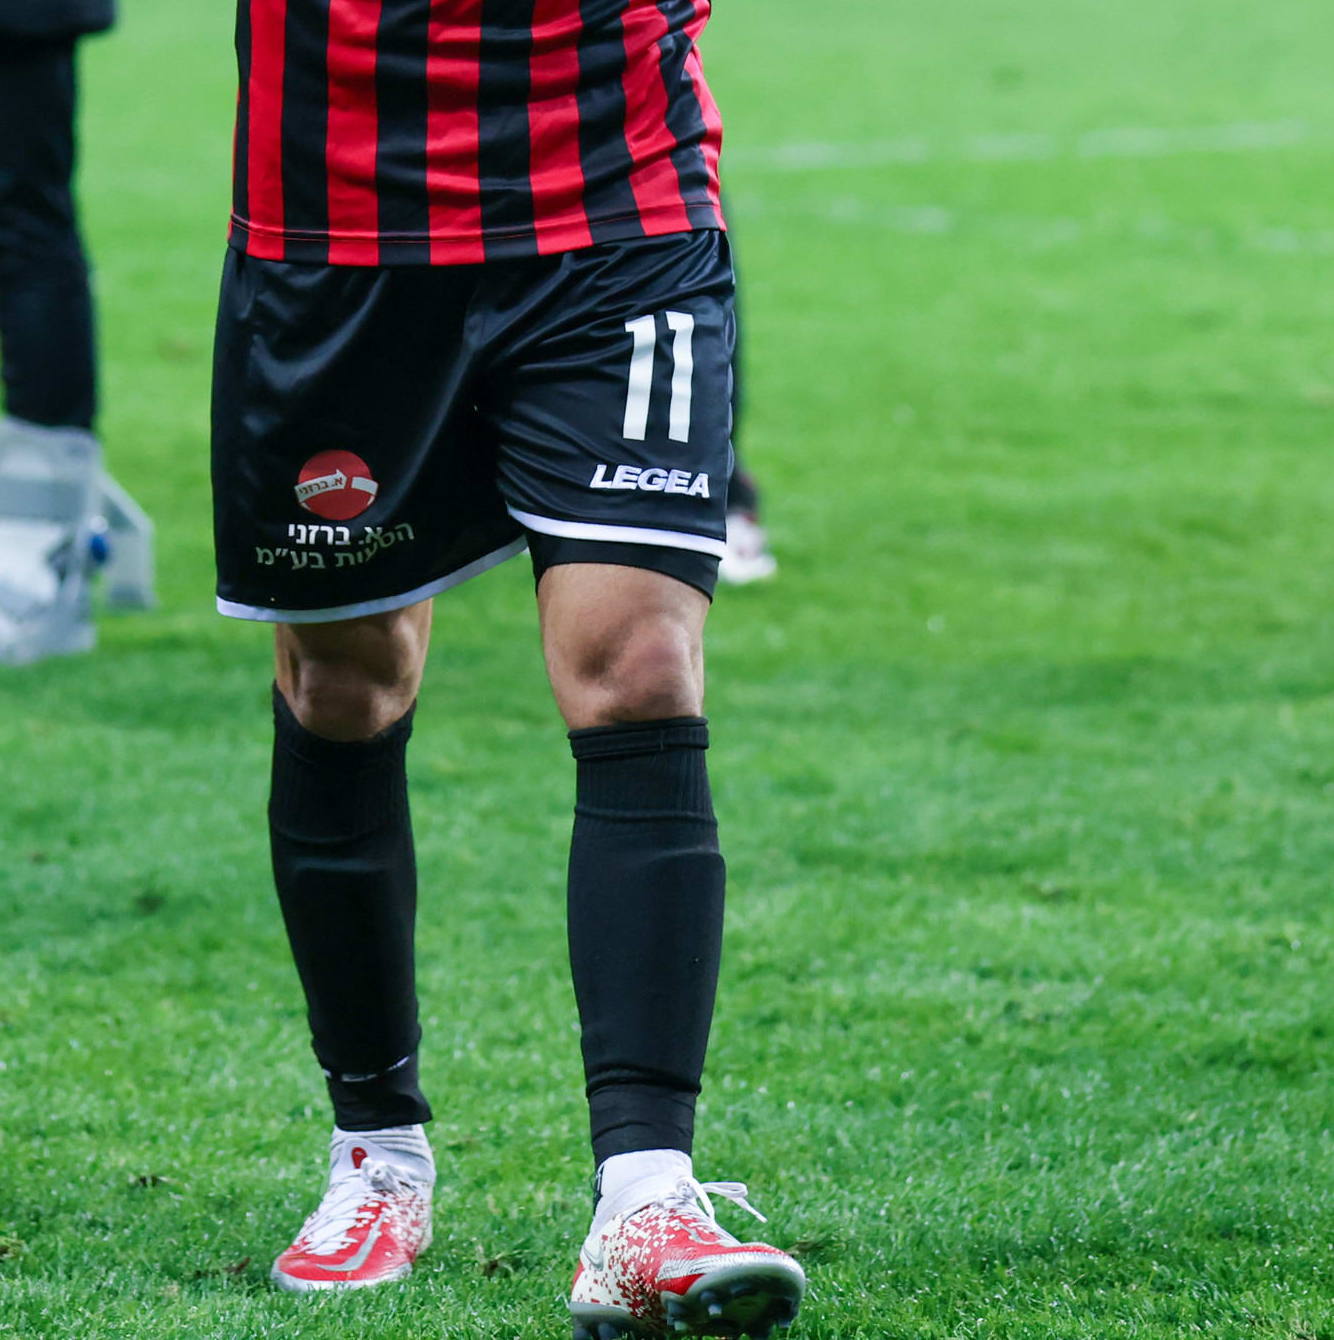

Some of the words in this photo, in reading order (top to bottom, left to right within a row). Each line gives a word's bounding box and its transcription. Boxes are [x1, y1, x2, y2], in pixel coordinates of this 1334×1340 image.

[623, 311, 695, 443] 11
[590, 464, 710, 499] LEGEA
[288, 523, 351, 545] ברזני
